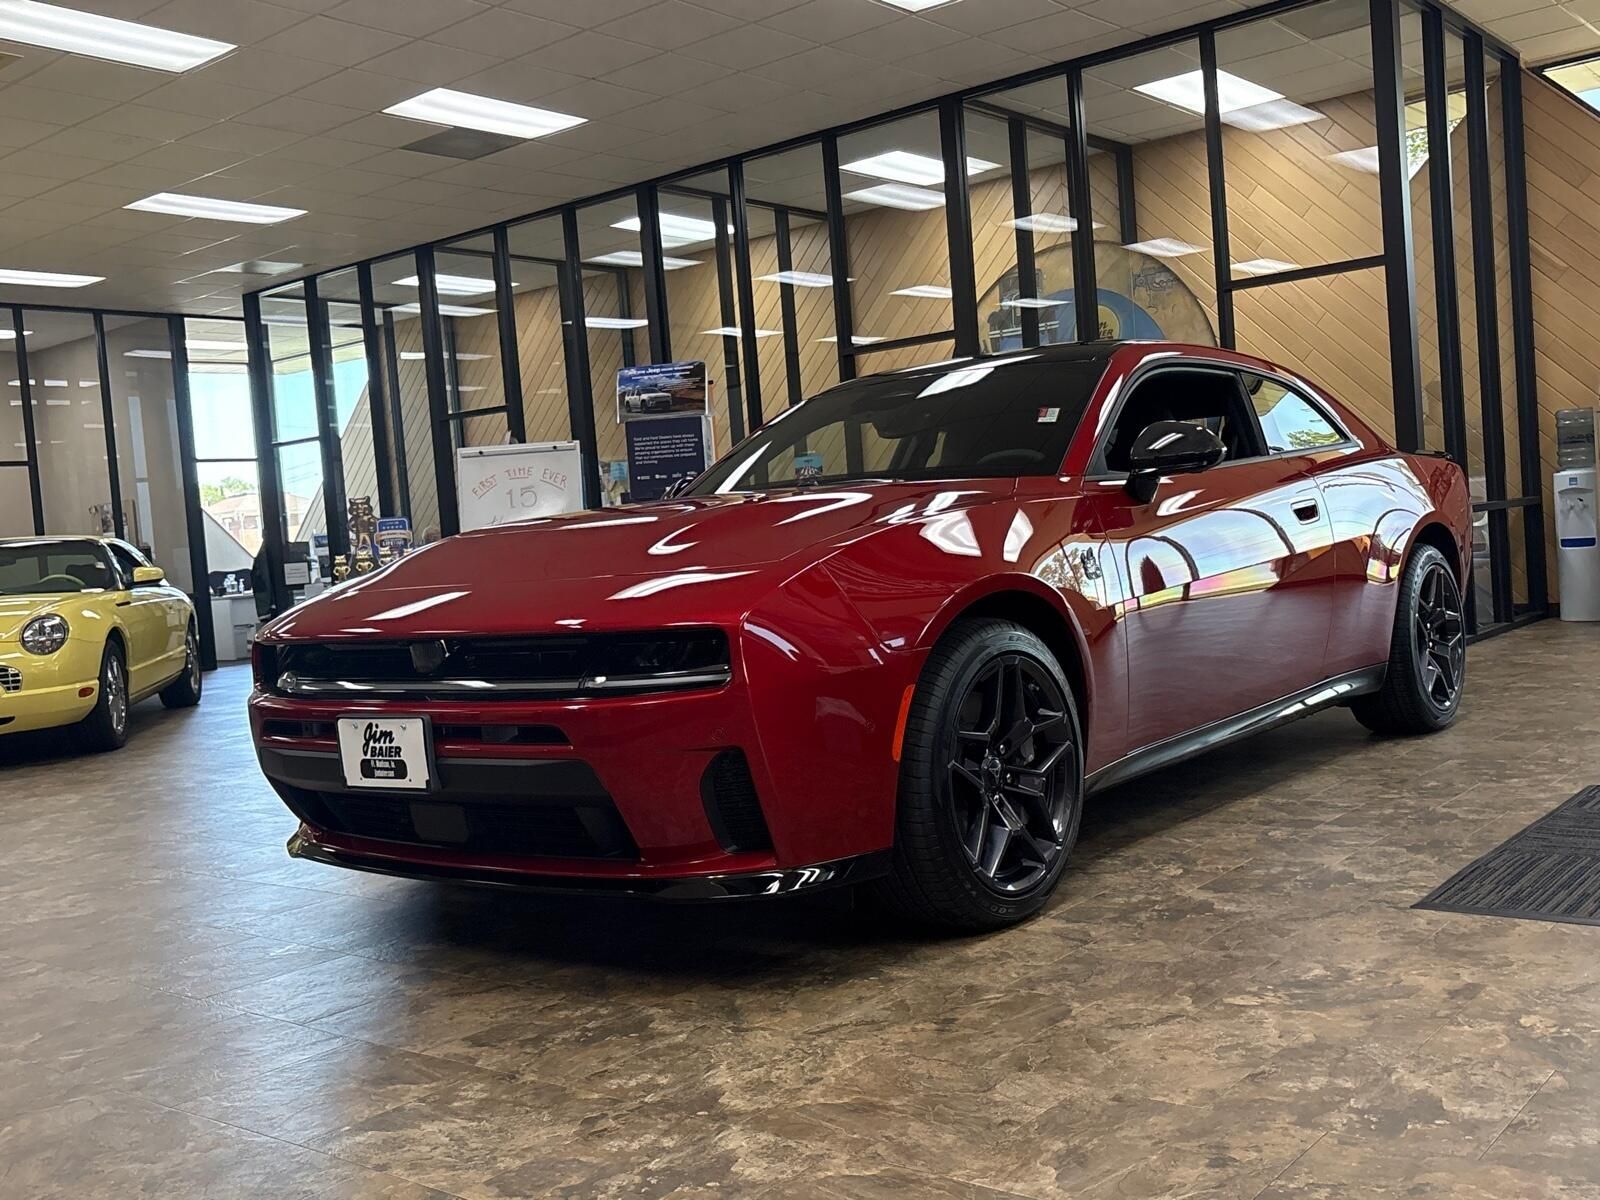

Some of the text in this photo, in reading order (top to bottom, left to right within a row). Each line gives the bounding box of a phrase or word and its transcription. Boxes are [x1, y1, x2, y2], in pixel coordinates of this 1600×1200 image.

[472, 467, 567, 497] FIRST TIME EVER
[506, 485, 537, 509] 15
[362, 722, 395, 757] Jim
[370, 746, 402, 758] BAIER
